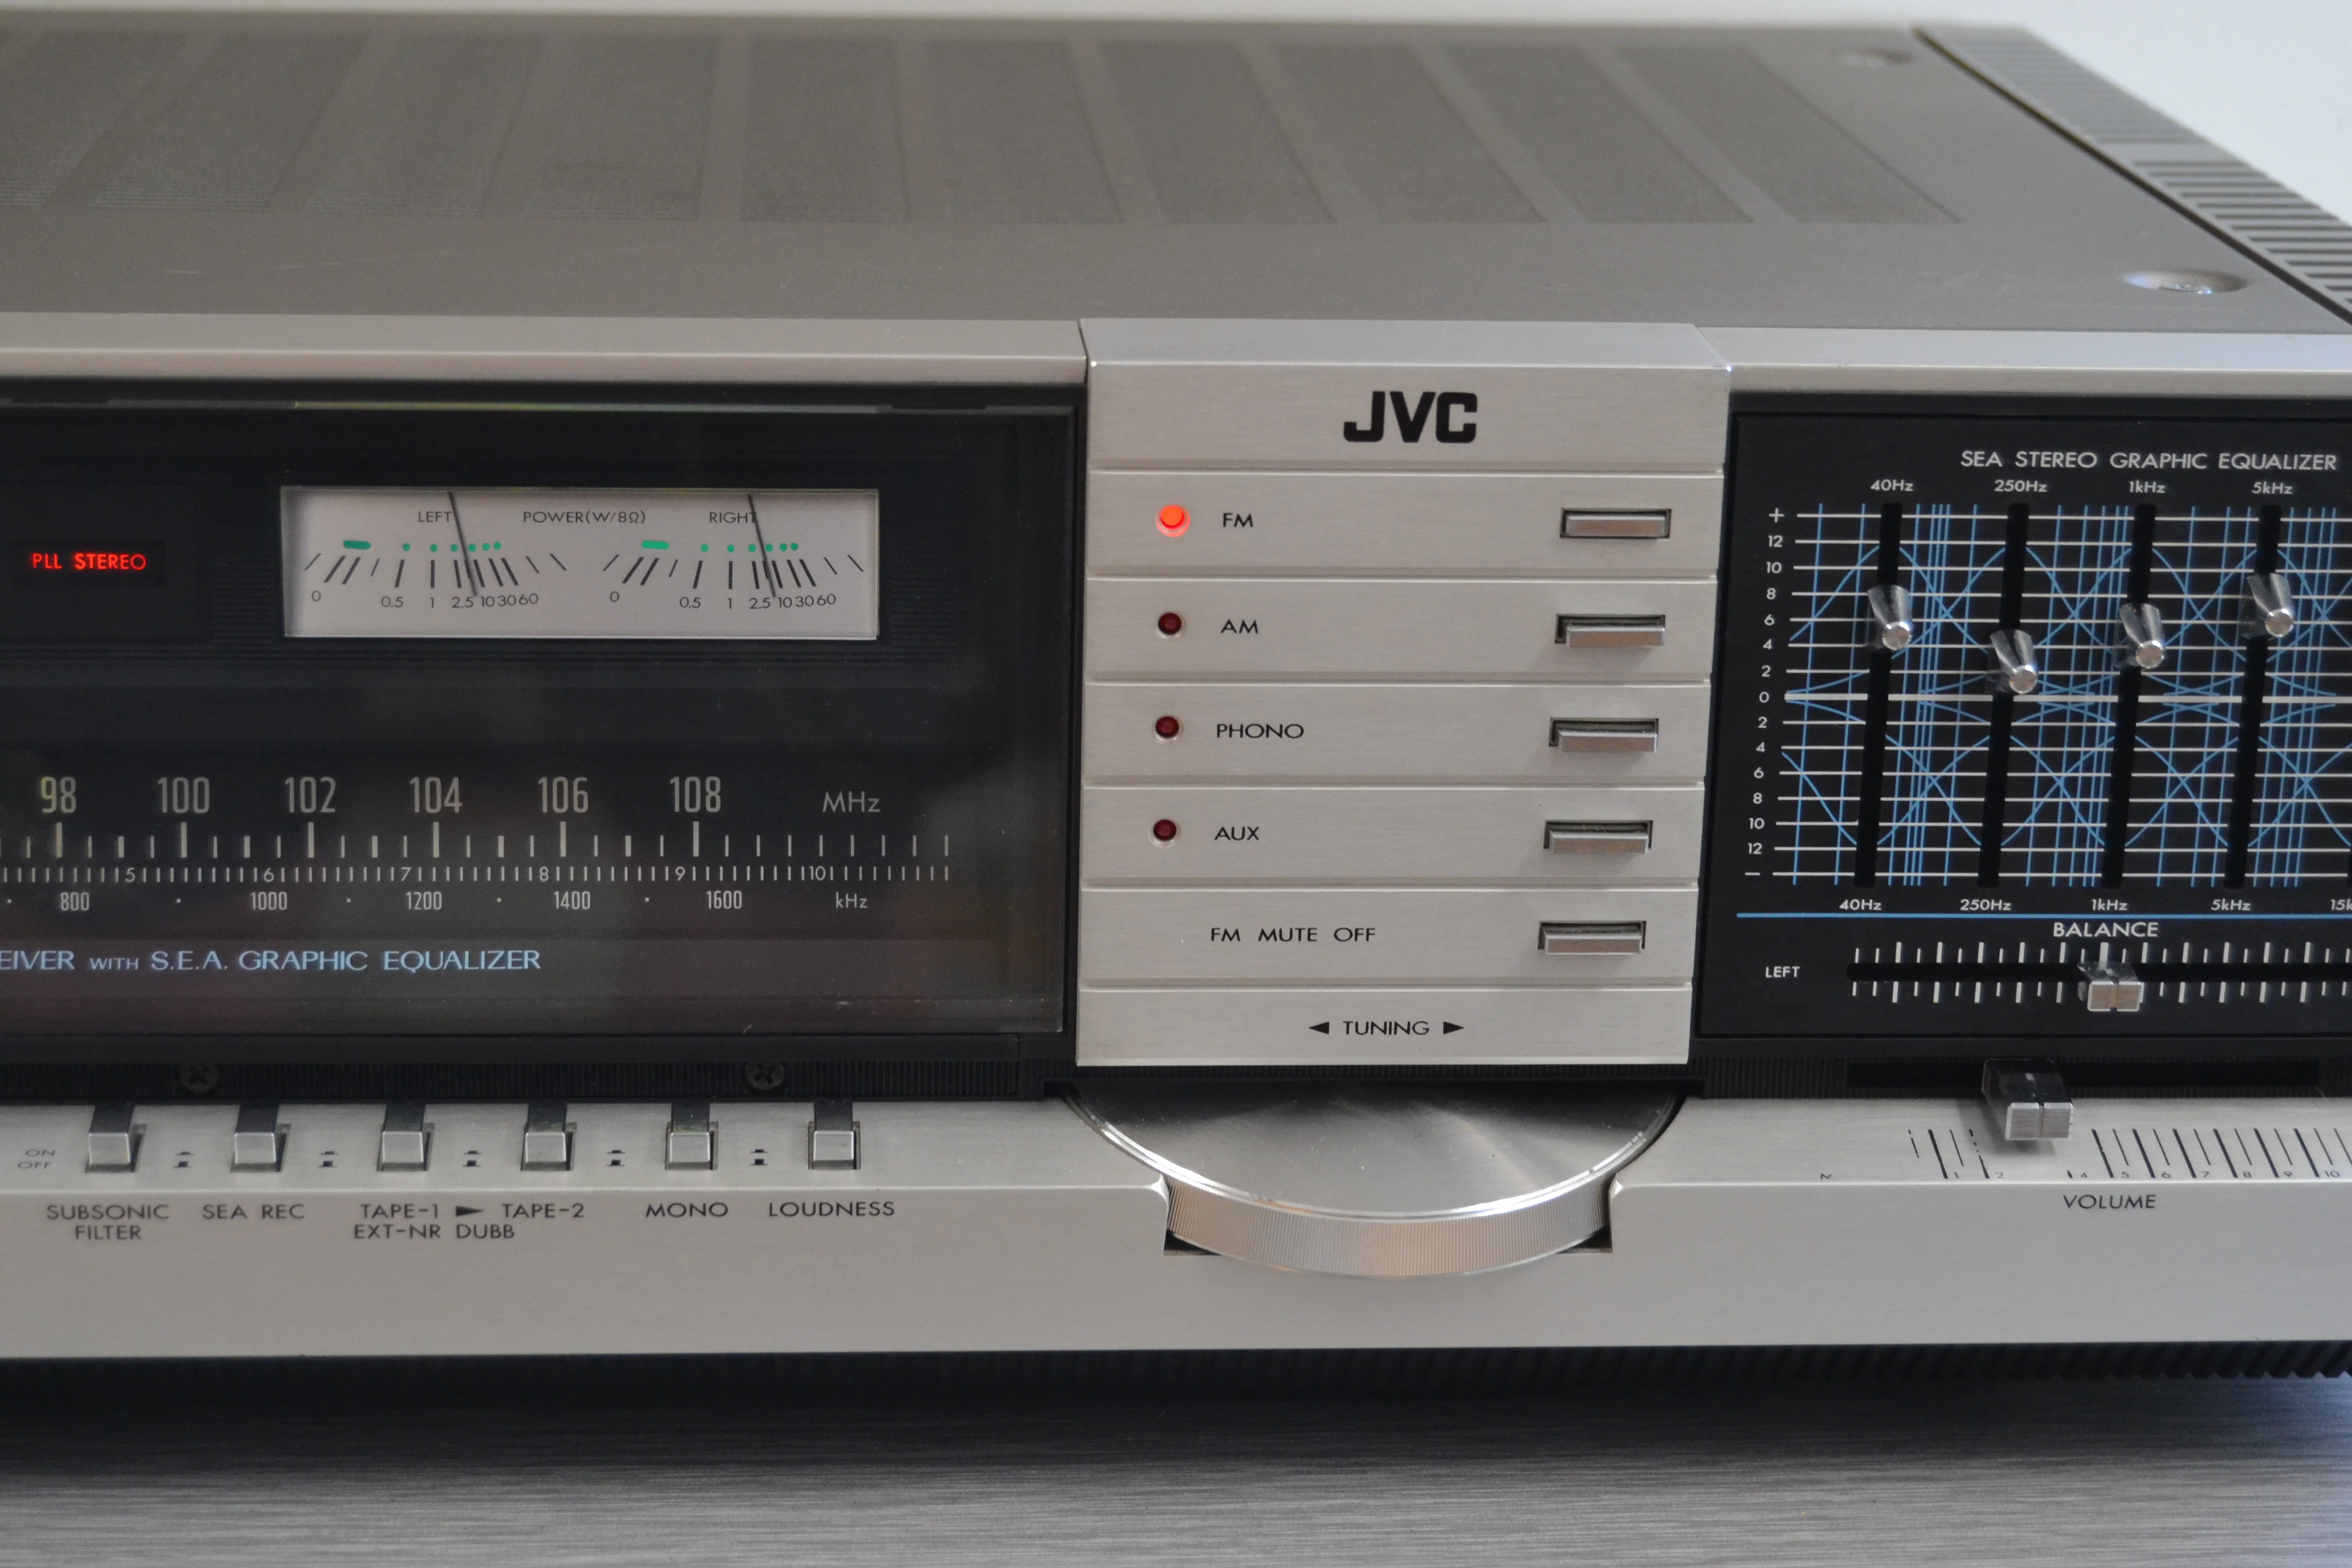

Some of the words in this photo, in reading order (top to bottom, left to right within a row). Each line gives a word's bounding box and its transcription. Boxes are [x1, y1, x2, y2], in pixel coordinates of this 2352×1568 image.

[1343, 390, 1478, 444] JVC
[1961, 450, 2003, 467] SEA
[2015, 451, 2098, 469] STEREO
[2110, 452, 2208, 470] GRAPHIC
[2218, 453, 2337, 471] EQUALIZER
[1870, 479, 1914, 492] 40Hz
[1994, 479, 2047, 493] 250Hz
[2129, 480, 2166, 494] 1kHz
[2251, 481, 2293, 495] 5kHz
[418, 508, 453, 523] LEFT
[709, 511, 756, 524] RIGHT
[1222, 512, 1254, 527] FM
[1768, 535, 1783, 548] 12
[32, 553, 63, 570] PLL
[74, 552, 146, 570] STEREO
[1766, 561, 1782, 574] 10
[311, 590, 322, 602] 0
[380, 596, 404, 608] 0.5
[430, 597, 434, 608] 1
[451, 596, 474, 608] 2.5
[480, 596, 495, 607] 10
[498, 594, 517, 607] 30
[518, 593, 539, 605] 60
[609, 591, 620, 603] 0
[679, 596, 701, 609] 0.5
[728, 598, 732, 609] 1
[749, 597, 771, 609] 2.5
[777, 597, 793, 608] 10
[795, 595, 815, 607] 30
[816, 593, 837, 606] 60
[1766, 587, 1776, 600] 8
[1220, 619, 1259, 634] AM
[1764, 614, 1775, 626] 6
[1762, 639, 1773, 650] 4
[1761, 665, 1771, 677] 2
[1759, 691, 1770, 703] 0
[1758, 716, 1768, 728] 2
[1216, 723, 1305, 739] PHONO
[1756, 742, 1766, 753] 4
[1753, 767, 1765, 779] 6
[40, 776, 76, 814] 98
[158, 776, 210, 814] 100
[285, 776, 336, 814] 102
[410, 777, 463, 814] 104
[538, 776, 589, 814] 106
[670, 776, 721, 813] 108
[822, 791, 881, 813] MHz
[1753, 792, 1762, 804] 8
[1749, 817, 1765, 829] 10
[1214, 826, 1259, 841] AUX
[1748, 842, 1762, 854] 12
[125, 867, 135, 883] 5
[263, 867, 275, 883] 6
[401, 866, 412, 881] 7
[539, 866, 549, 882] 8
[675, 866, 686, 881] 9
[808, 865, 826, 881] 10
[60, 891, 90, 911] 800
[251, 891, 287, 911] 1000
[406, 891, 442, 910] 1200
[554, 891, 591, 910] 1400
[706, 890, 742, 909] 1600
[836, 891, 868, 909] kHz
[1839, 898, 1881, 911] 40Hz
[1960, 898, 2011, 911] 250Hz
[2092, 898, 2127, 911] 1kHz
[2211, 898, 2251, 911] 5kHz
[1211, 927, 1241, 942] FM
[1258, 927, 1317, 942] MUTE
[1333, 927, 1375, 942] OFF
[2053, 921, 2159, 938] BALANCE
[90, 958, 139, 970] WITH
[151, 950, 228, 971] S.E.A.
[238, 950, 368, 971] GRAPHIC
[383, 950, 541, 973] EQUALIZER
[1765, 966, 1800, 978] LEFT
[1343, 1021, 1430, 1036] TUNING
[769, 1201, 895, 1217] LOUDNESS
[2063, 1194, 2156, 1210] VOLUME
[46, 1204, 169, 1220] SUBSONIC
[203, 1204, 247, 1220] SEA
[261, 1204, 304, 1219] REC
[360, 1204, 438, 1219] TAPE-1
[502, 1203, 584, 1218] TAPE-2
[646, 1202, 728, 1218] MONO
[75, 1225, 141, 1240] FILTER
[354, 1223, 440, 1239] EXT-NR
[456, 1223, 515, 1239] DUBB
